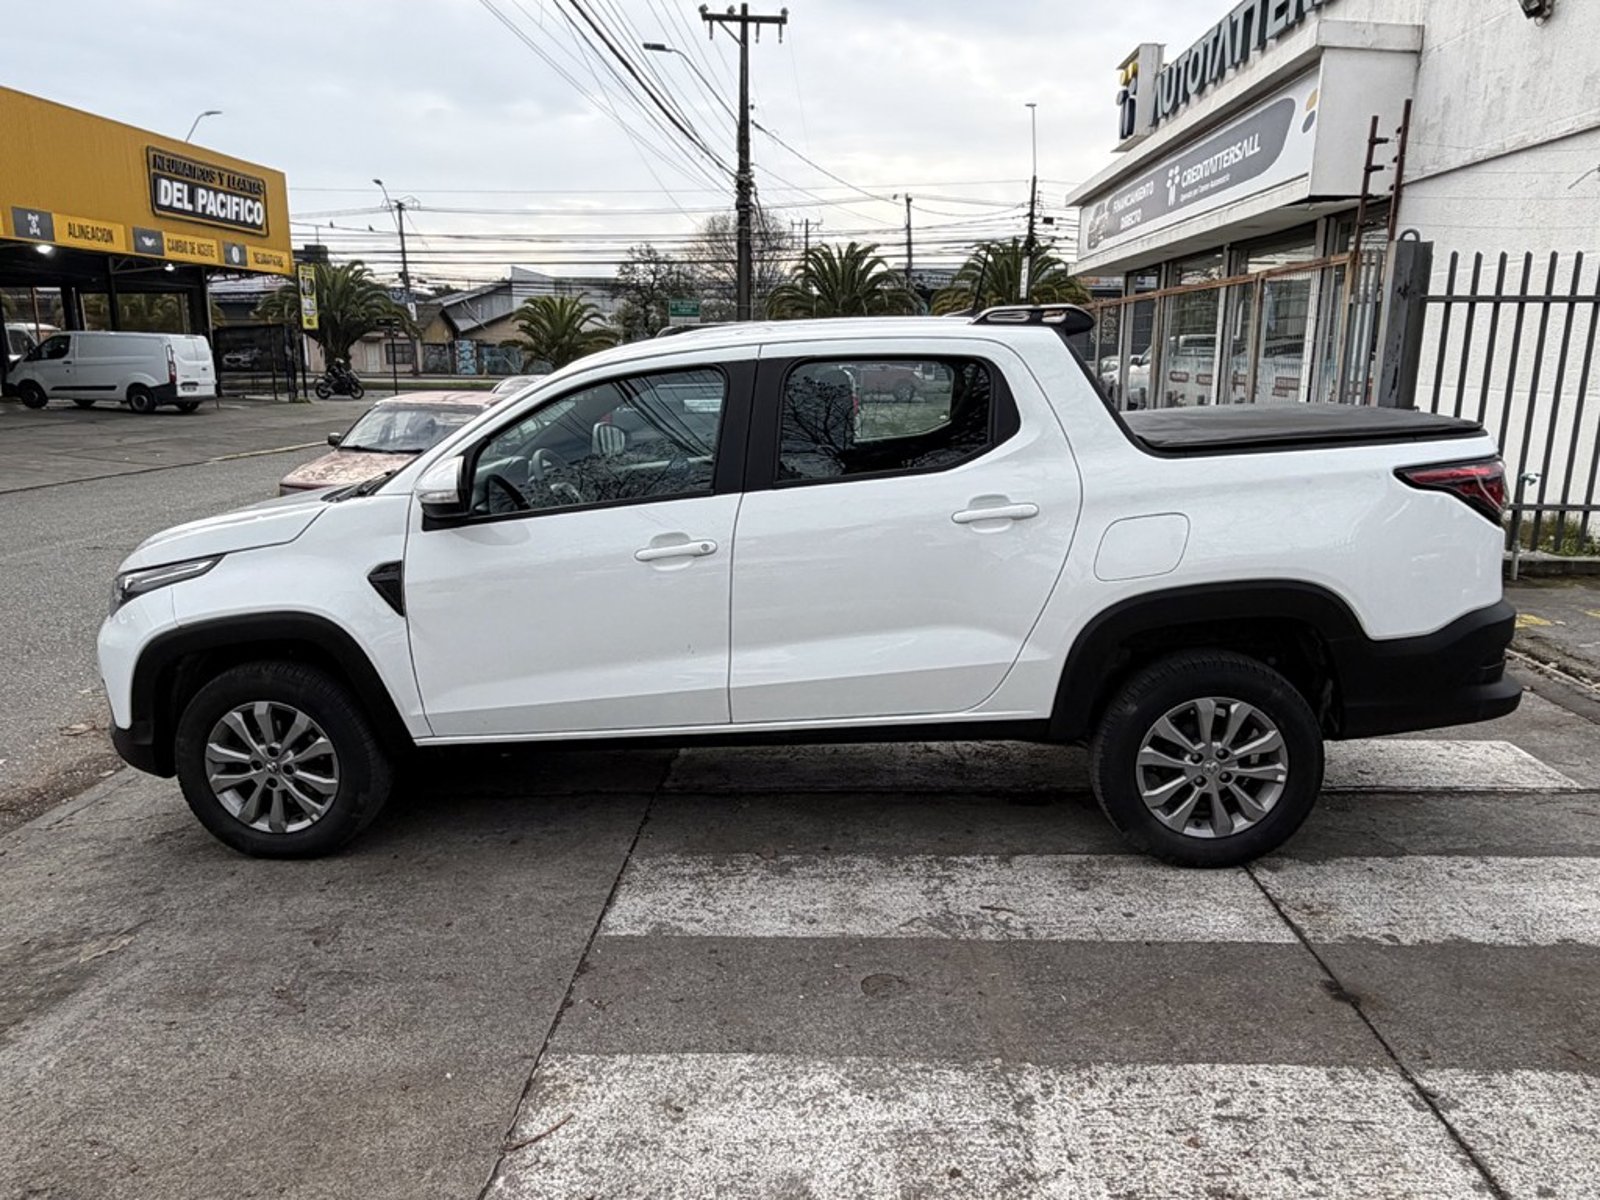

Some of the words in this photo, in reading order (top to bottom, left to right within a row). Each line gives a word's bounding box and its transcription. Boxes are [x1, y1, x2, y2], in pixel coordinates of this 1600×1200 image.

[216, 172, 226, 186] Y
[157, 178, 192, 212] DEL
[194, 187, 264, 226] PACIFICO
